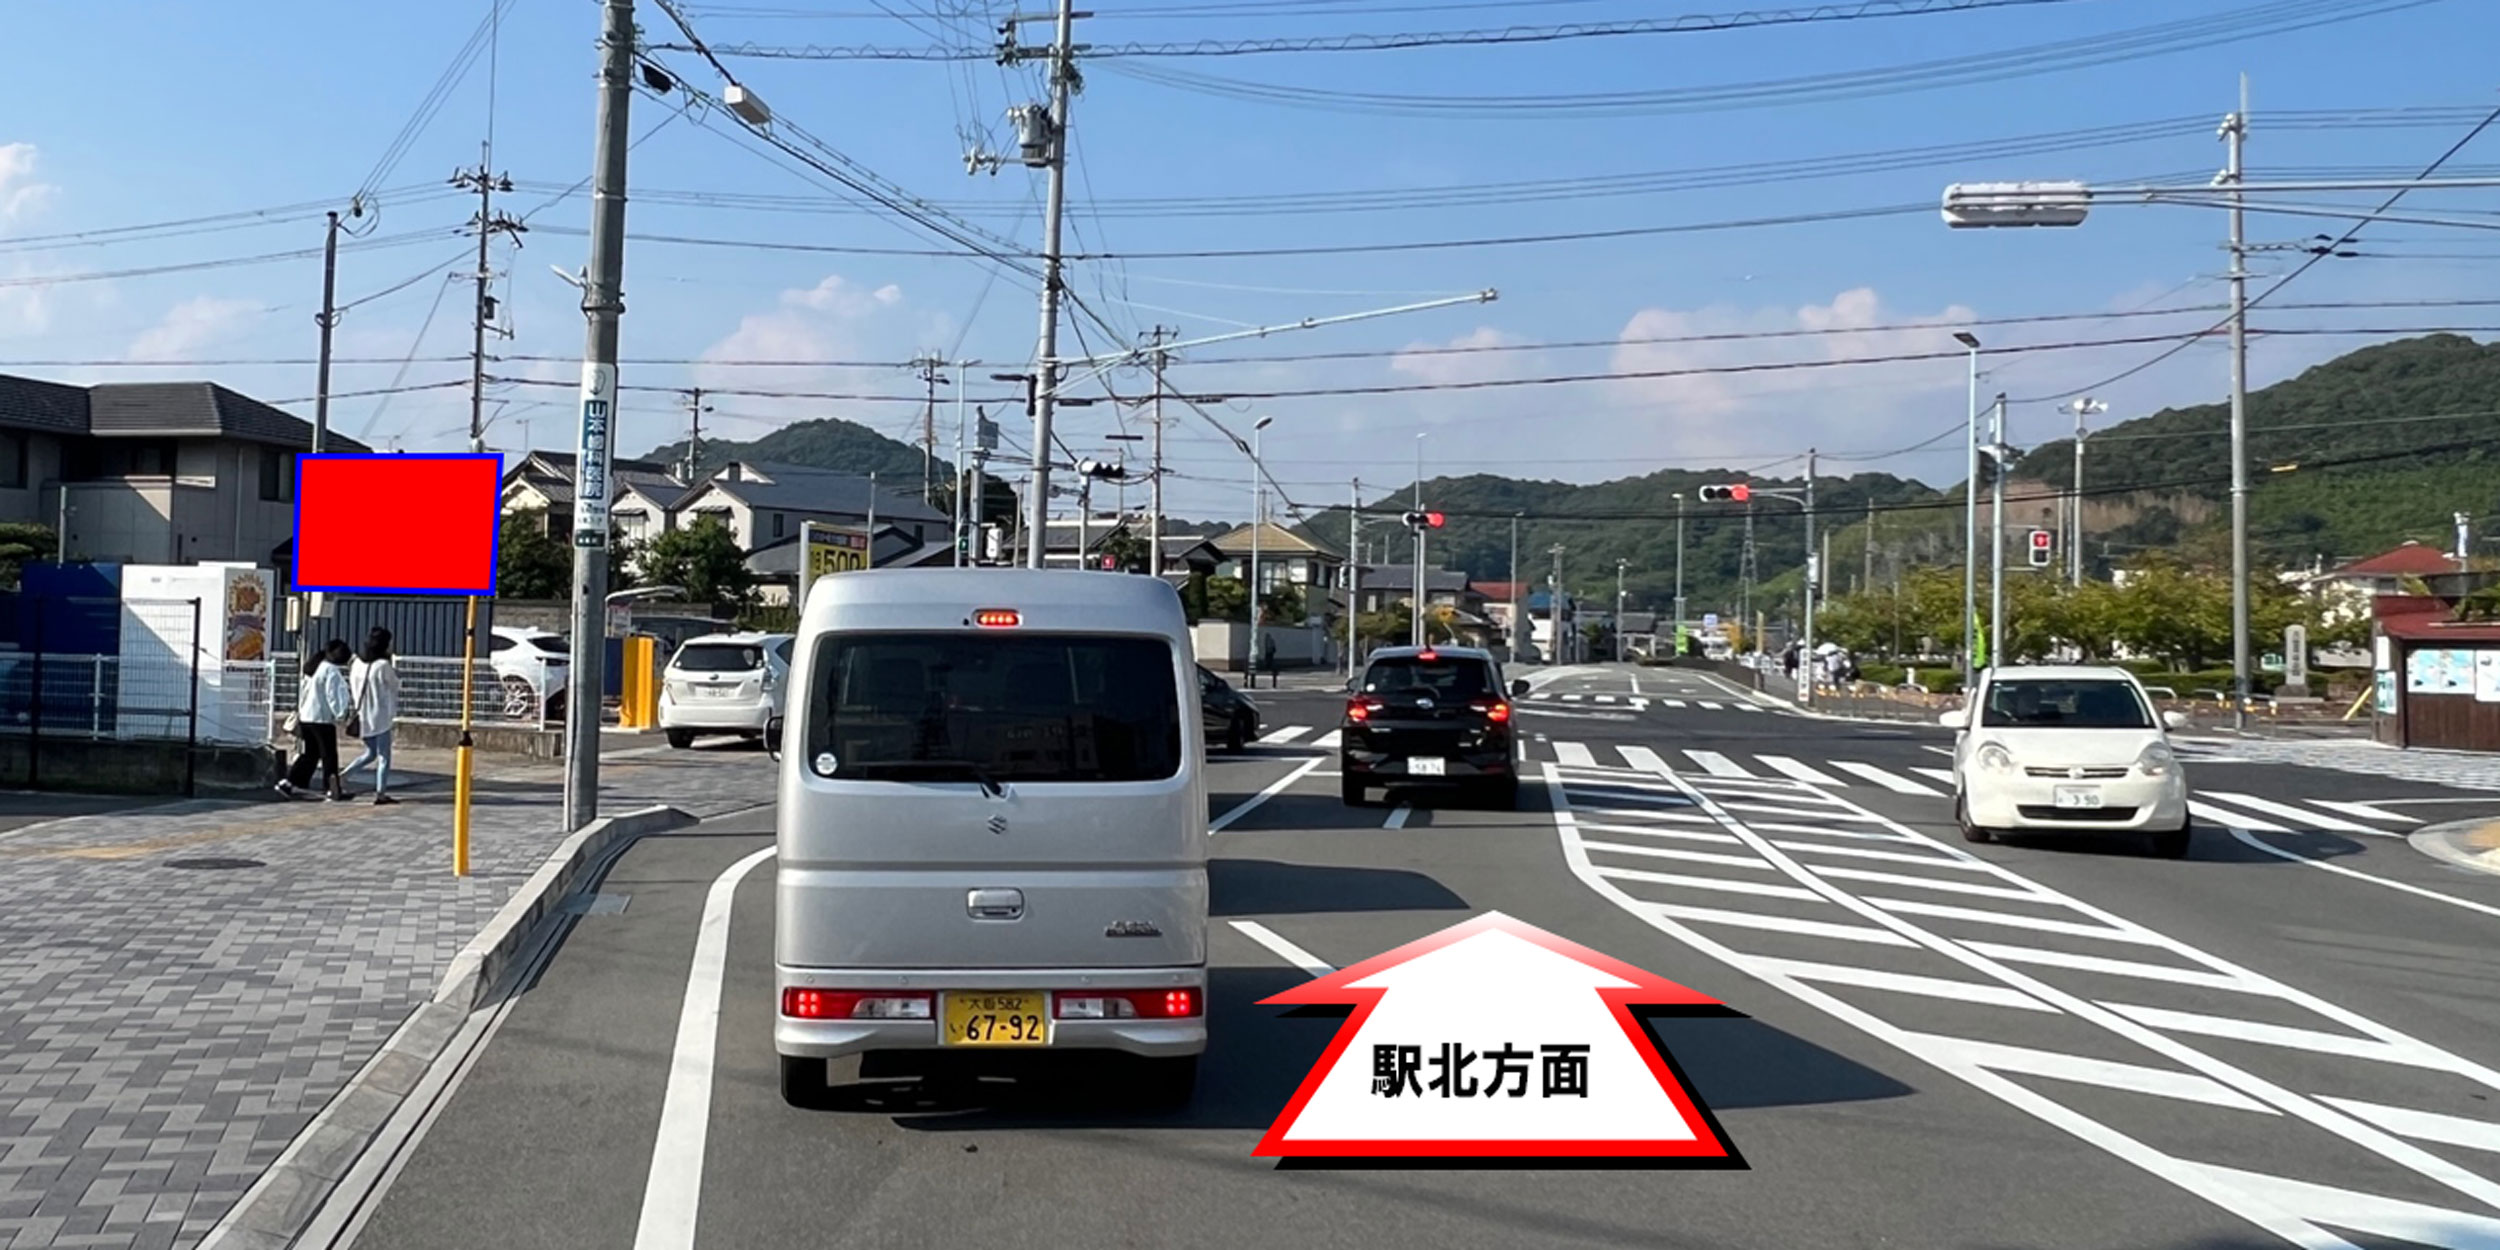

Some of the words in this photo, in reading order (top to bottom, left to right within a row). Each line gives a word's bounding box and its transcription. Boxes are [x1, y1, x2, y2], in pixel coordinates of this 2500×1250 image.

[585, 402, 606, 498] 山本歯科医院
[824, 549, 861, 574] 500
[966, 1014, 1040, 1041] 67-92
